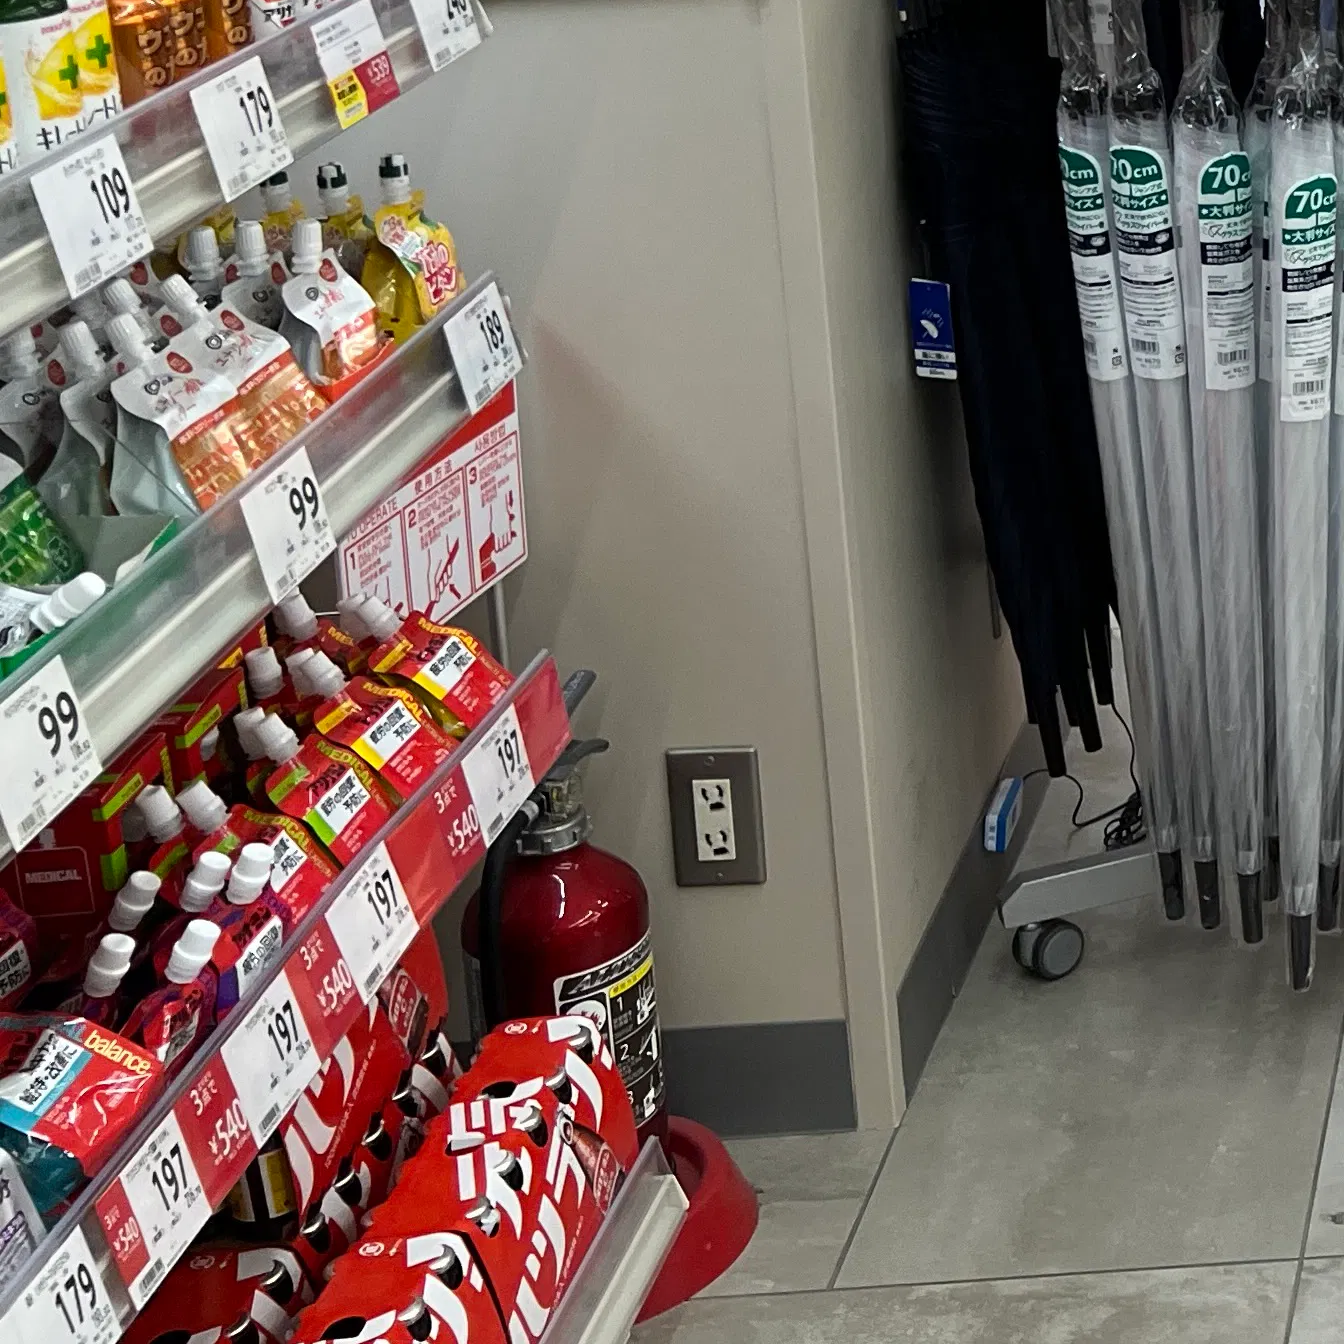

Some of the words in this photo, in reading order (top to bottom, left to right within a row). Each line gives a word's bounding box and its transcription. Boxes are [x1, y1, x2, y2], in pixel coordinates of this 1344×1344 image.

[238, 85, 275, 138] 179
[89, 166, 131, 225] 109
[477, 309, 505, 352] 189
[287, 476, 320, 530] 99
[417, 617, 478, 657] MEDICAL
[36, 691, 81, 758] 99
[362, 681, 425, 721] MEDICAL
[315, 739, 374, 788] MEDICAL
[497, 729, 523, 780] 197
[447, 803, 479, 850] ¥540
[24, 868, 82, 885] MEDICAL
[366, 868, 398, 925] 197
[316, 958, 352, 1011] ¥540
[83, 1029, 153, 1076] balance
[266, 1000, 302, 1062] 197
[207, 1097, 250, 1156] ¥540
[151, 1141, 190, 1213] 197
[112, 1218, 140, 1253] ¥540
[53, 1261, 99, 1336] 179
